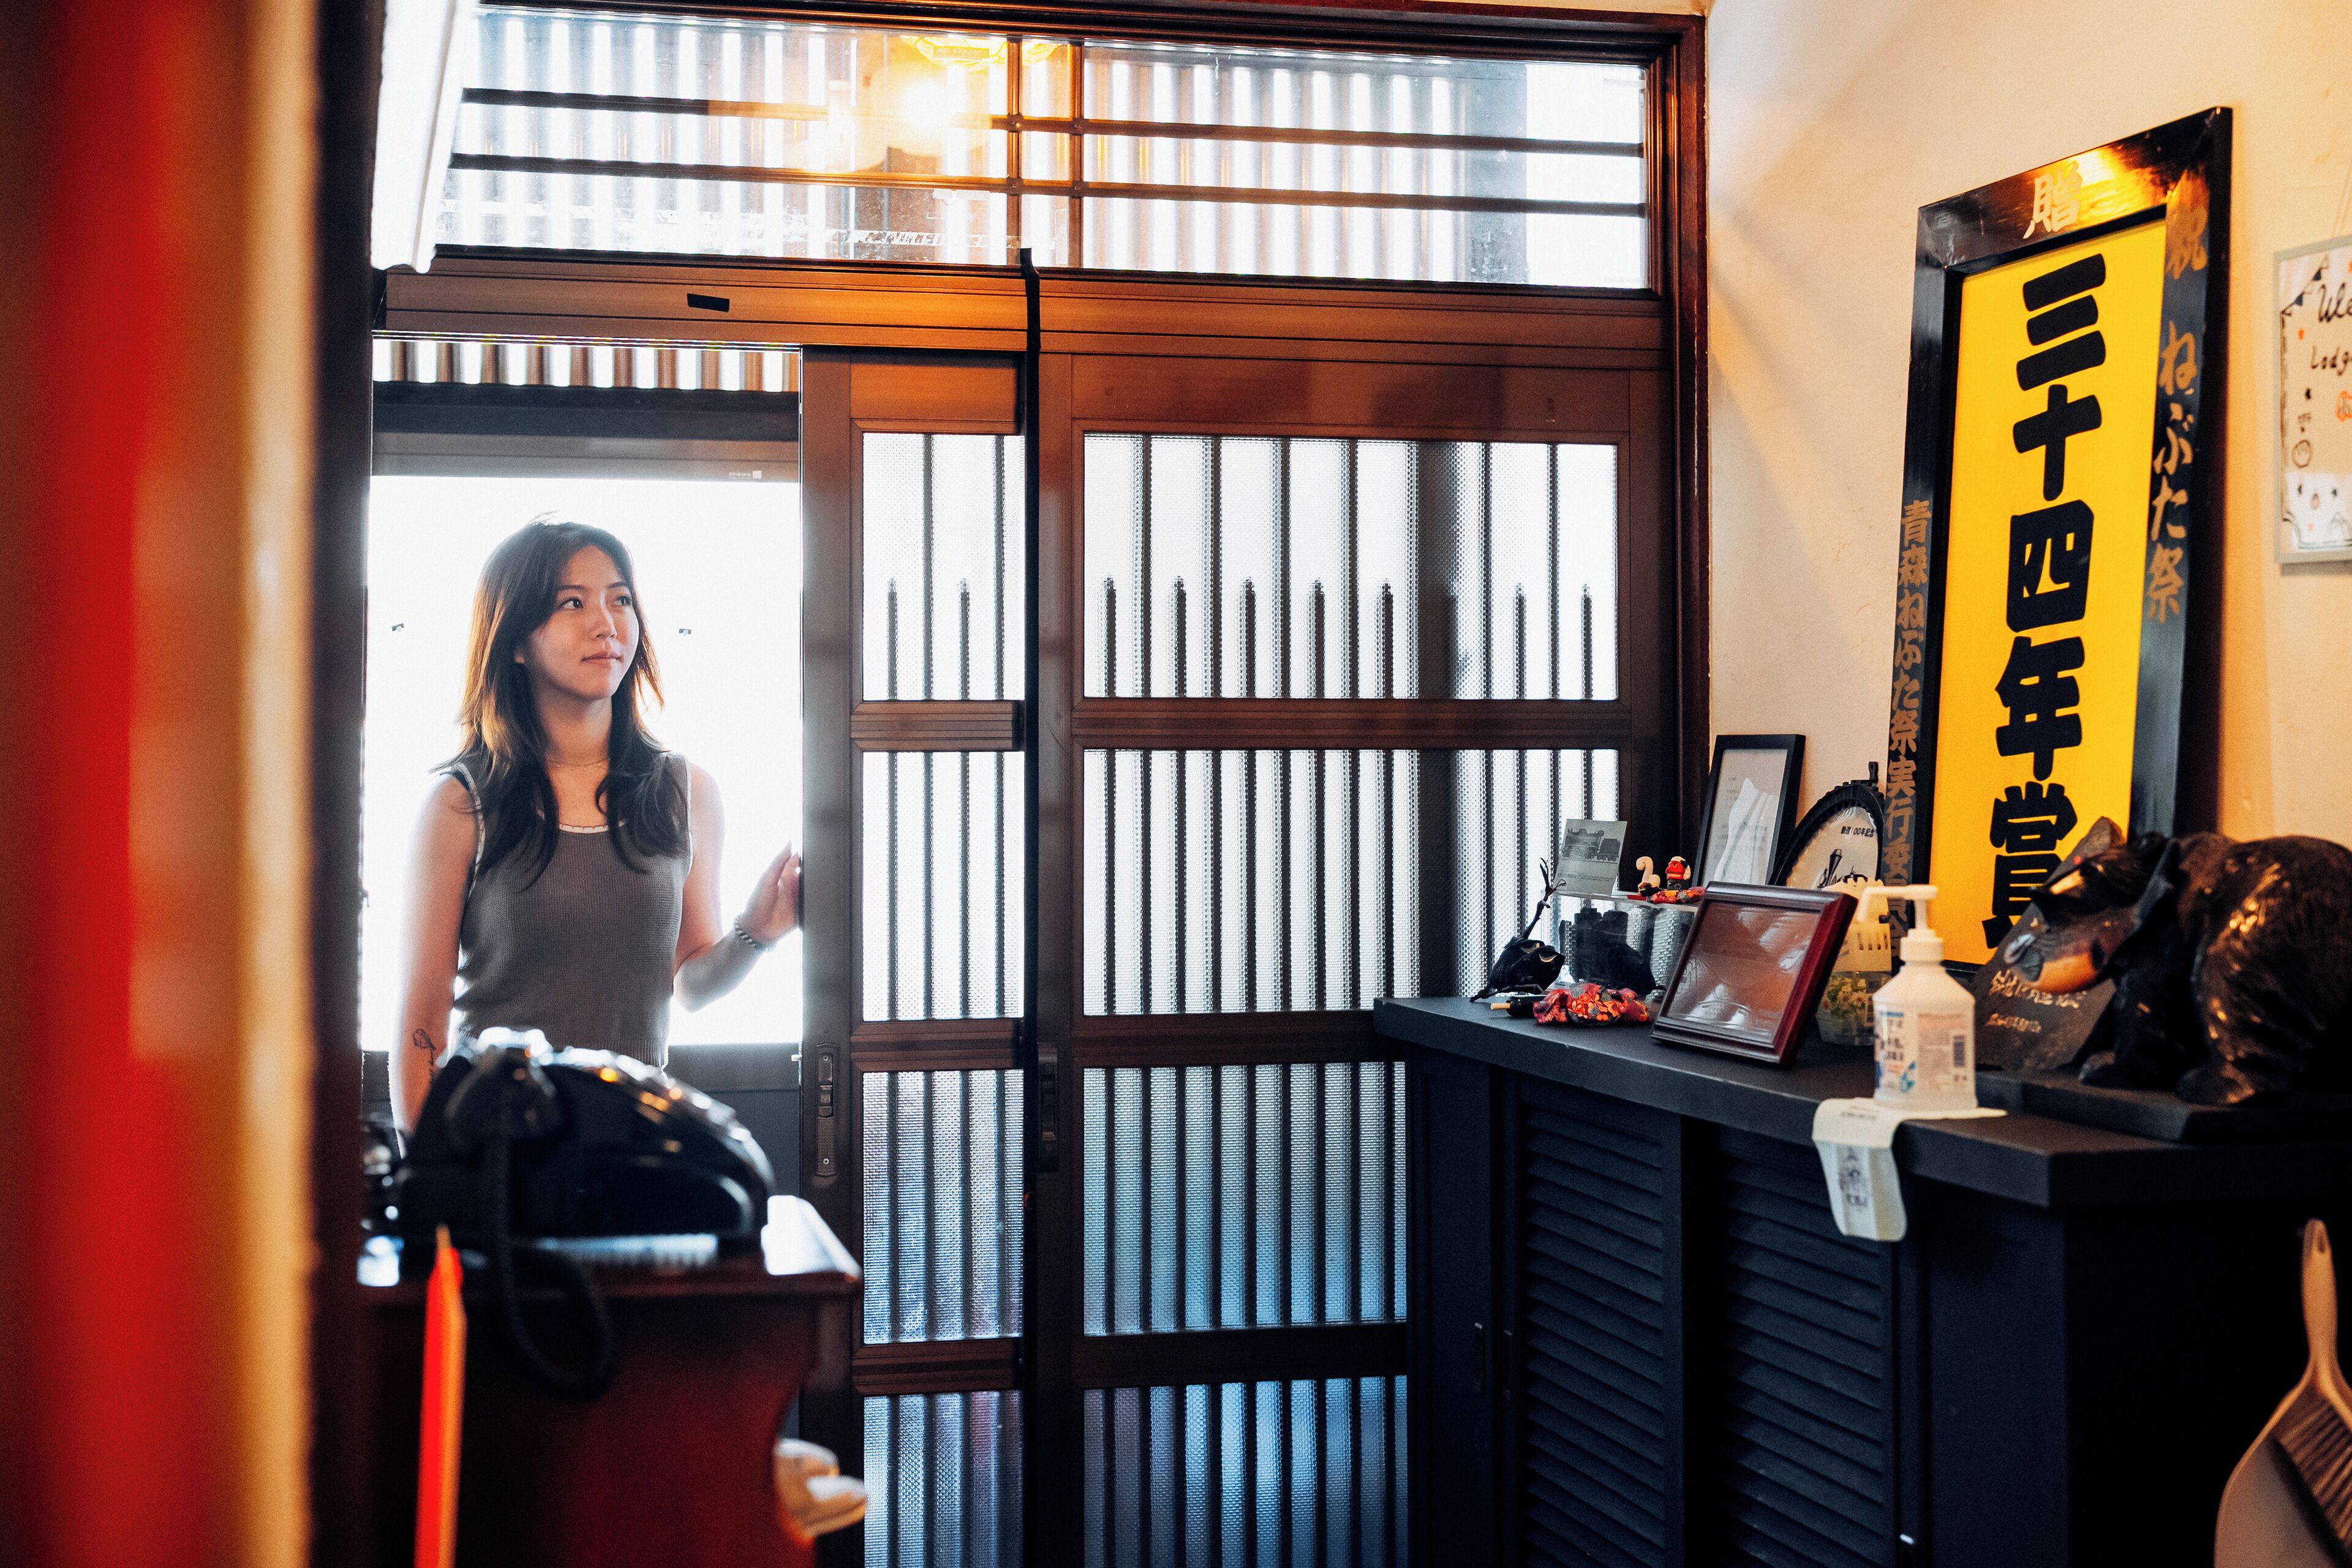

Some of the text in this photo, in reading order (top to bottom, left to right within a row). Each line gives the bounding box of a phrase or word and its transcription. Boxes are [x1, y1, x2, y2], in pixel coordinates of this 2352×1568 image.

[1981, 253, 2106, 949] 三十四年賞
[2146, 320, 2198, 624] ねぶた祭
